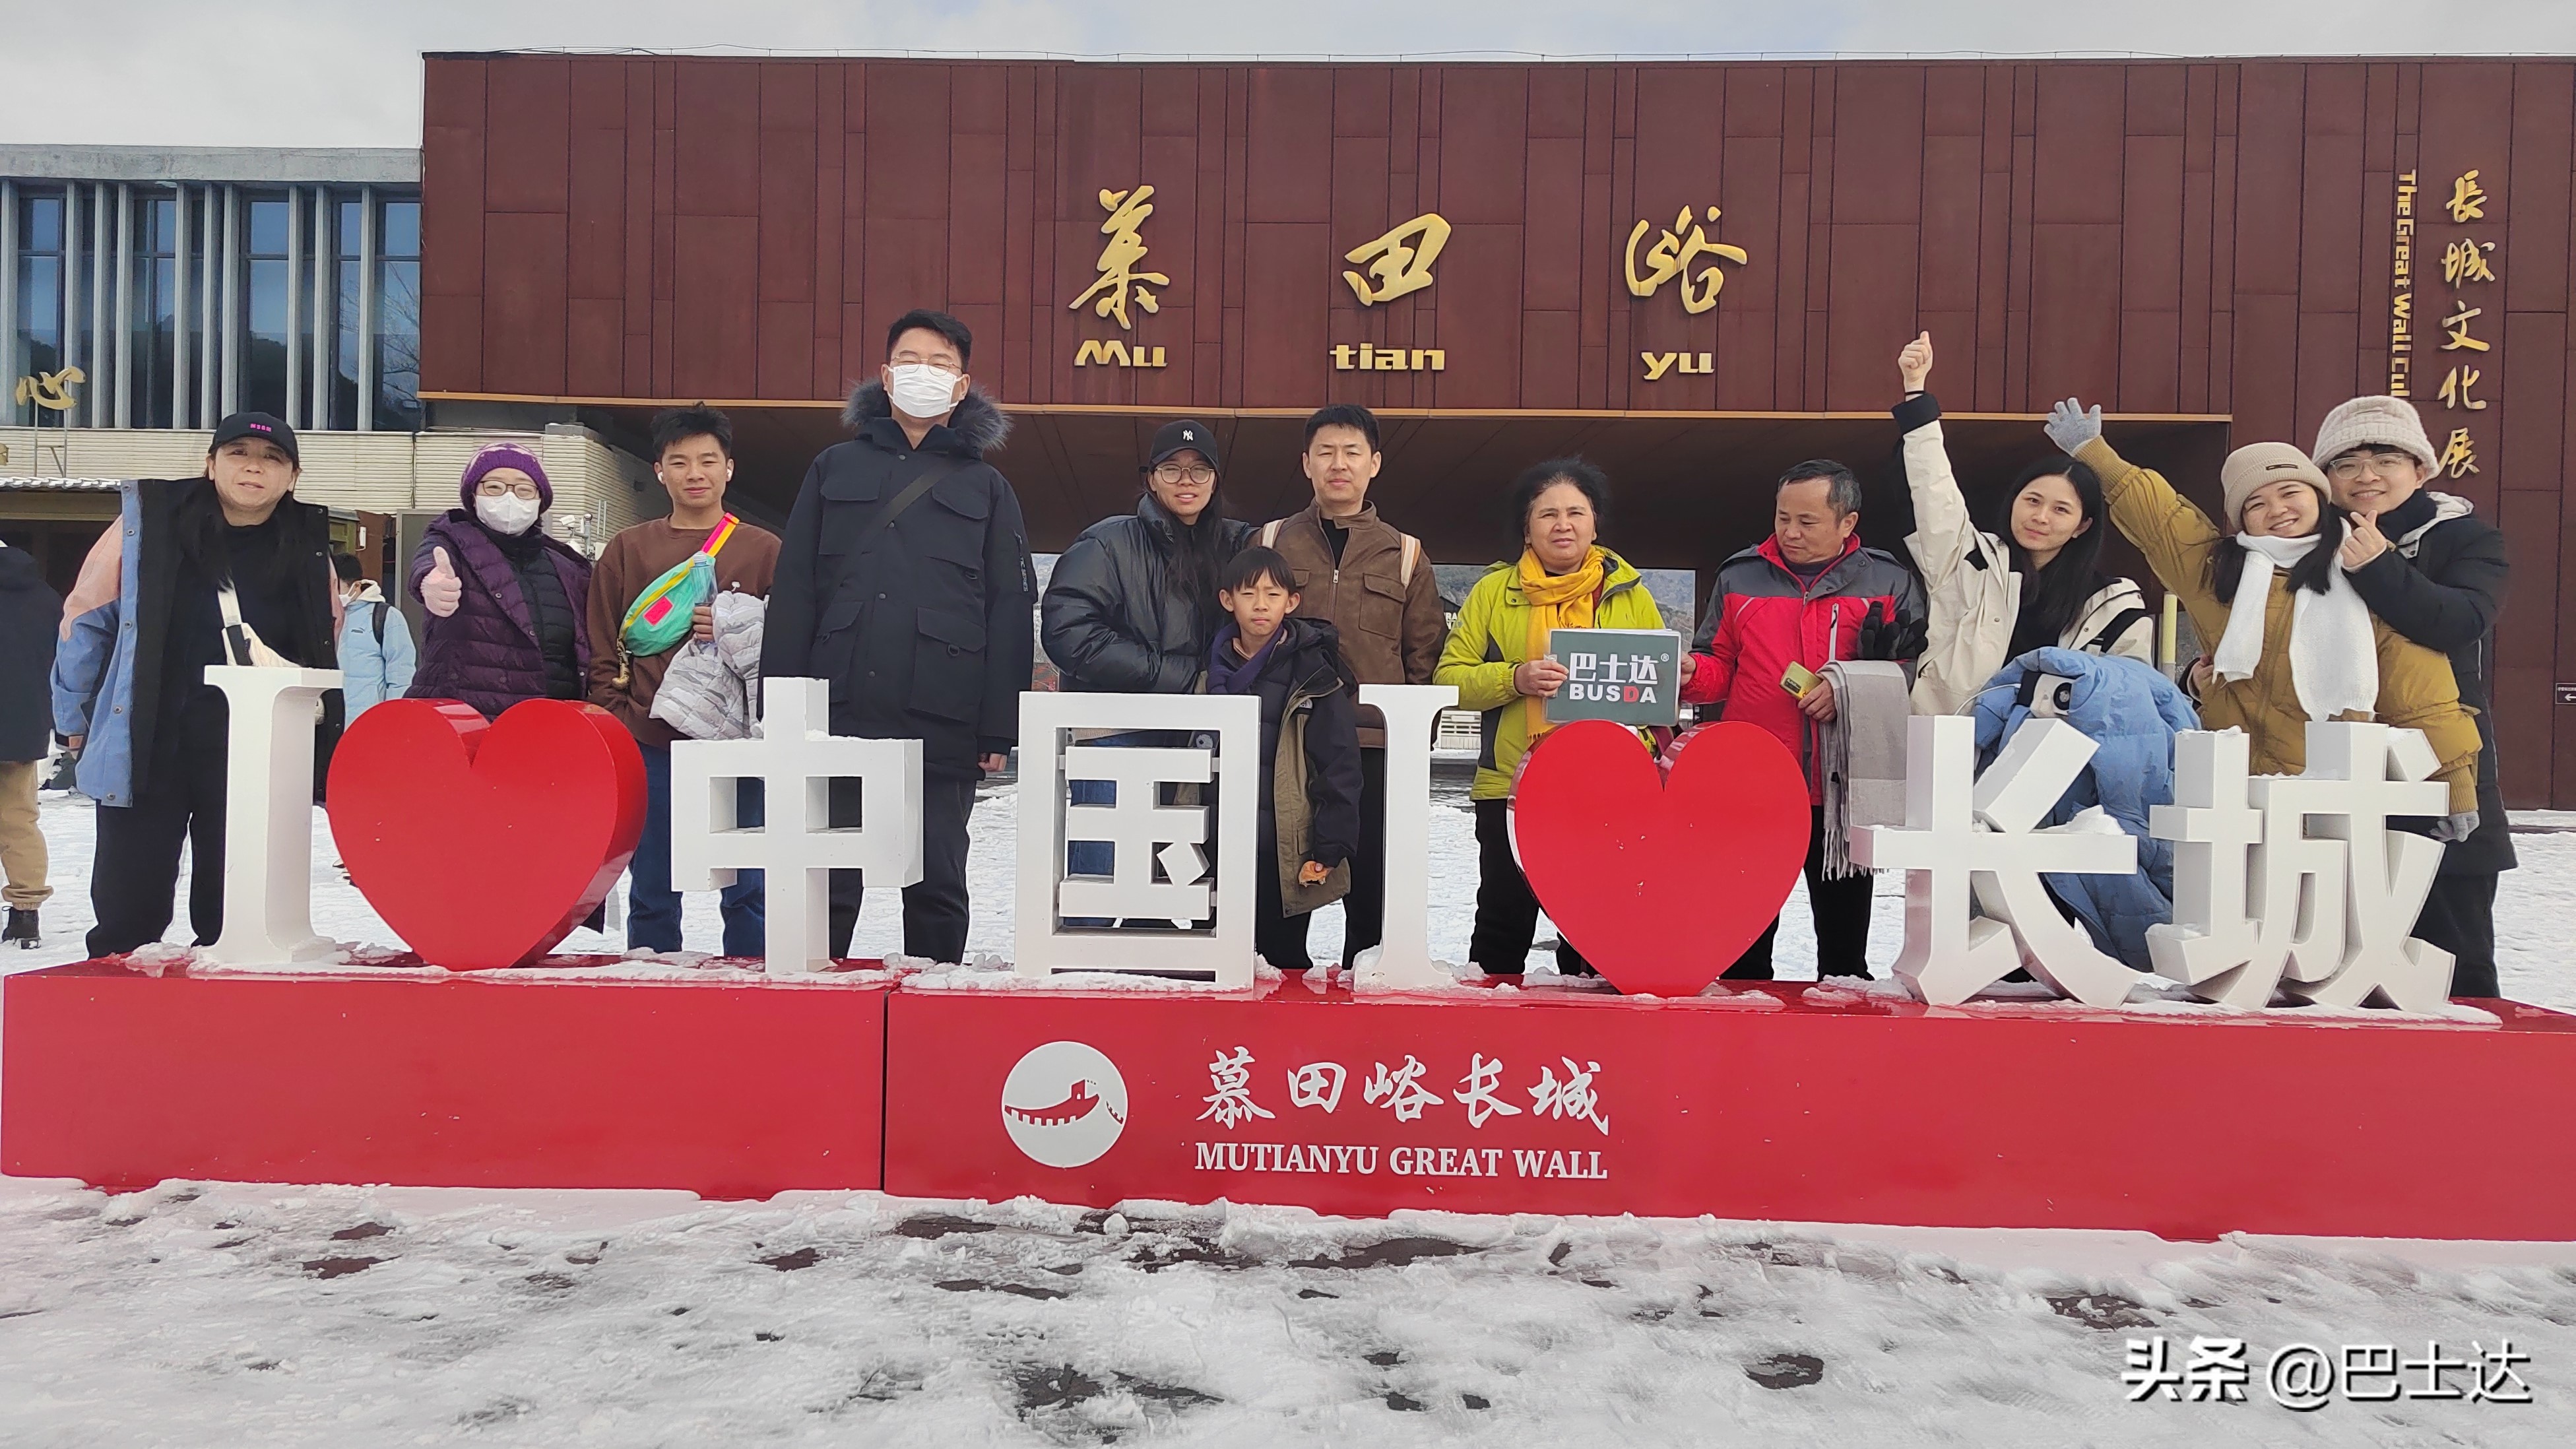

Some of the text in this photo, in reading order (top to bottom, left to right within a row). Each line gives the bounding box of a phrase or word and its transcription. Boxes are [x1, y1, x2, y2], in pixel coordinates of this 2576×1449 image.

[2397, 169, 2418, 216] The
[2394, 218, 2414, 288] Great
[2392, 293, 2412, 354] Wall
[1074, 340, 1715, 381] Mu tian yu
[16, 366, 86, 410] 心
[1569, 652, 1659, 685] 巴士达
[1569, 683, 1658, 704] BUSDA
[204, 666, 2456, 1011] I 中国 I 长城
[1195, 1046, 1609, 1136] 慕田峪长城
[1196, 1142, 1609, 1180] MUTIANYU GREAT WALL
